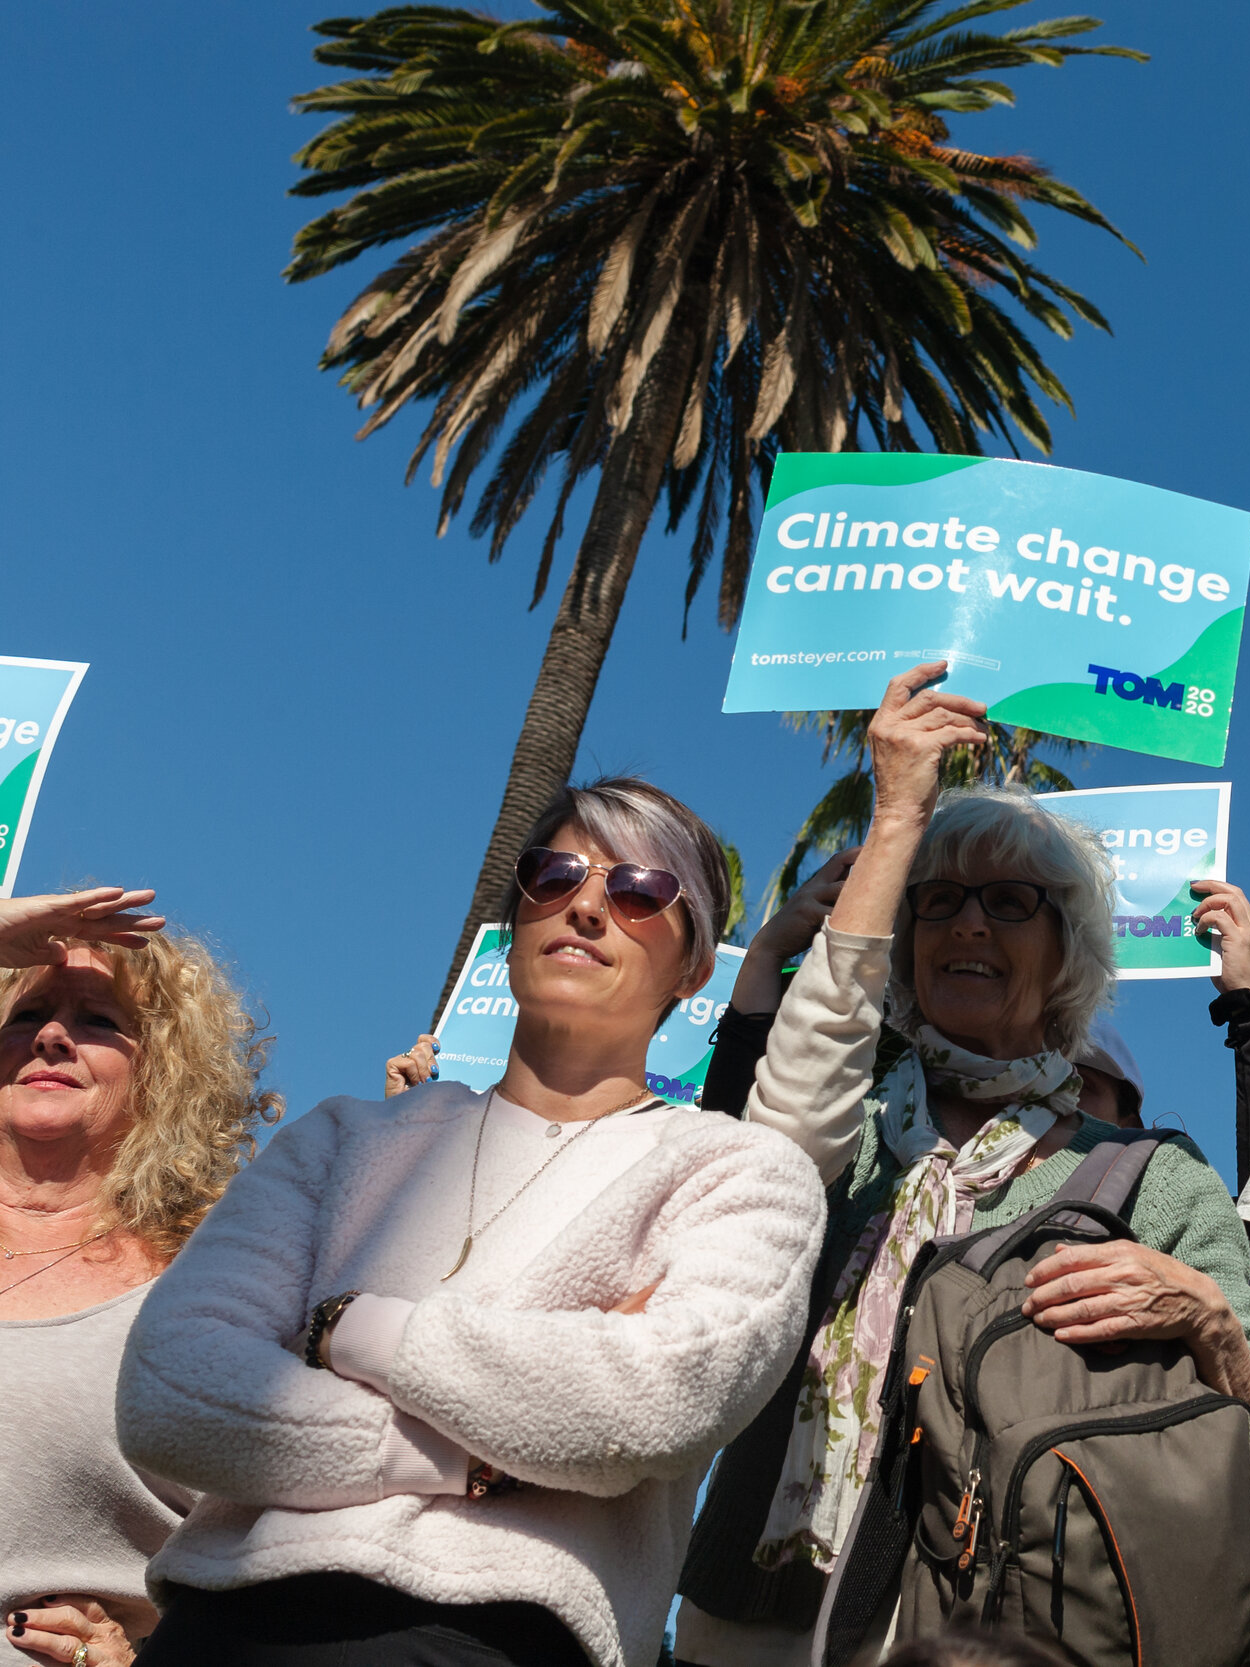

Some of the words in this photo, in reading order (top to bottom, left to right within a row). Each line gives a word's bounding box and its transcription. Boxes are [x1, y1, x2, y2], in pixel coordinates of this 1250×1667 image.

[776, 511, 1001, 553] Climate
[1015, 528, 1231, 604] change
[766, 557, 968, 594] cannot
[986, 567, 1133, 627] wait.
[750, 648, 887, 668] tomsteyer.com
[1087, 663, 1185, 711] TOM
[1187, 685, 1216, 704] 20
[1184, 700, 1214, 718] 20
[1100, 828, 1209, 856] ange
[1112, 915, 1182, 938] TOM
[436, 1052, 509, 1067] omsteyer.co
